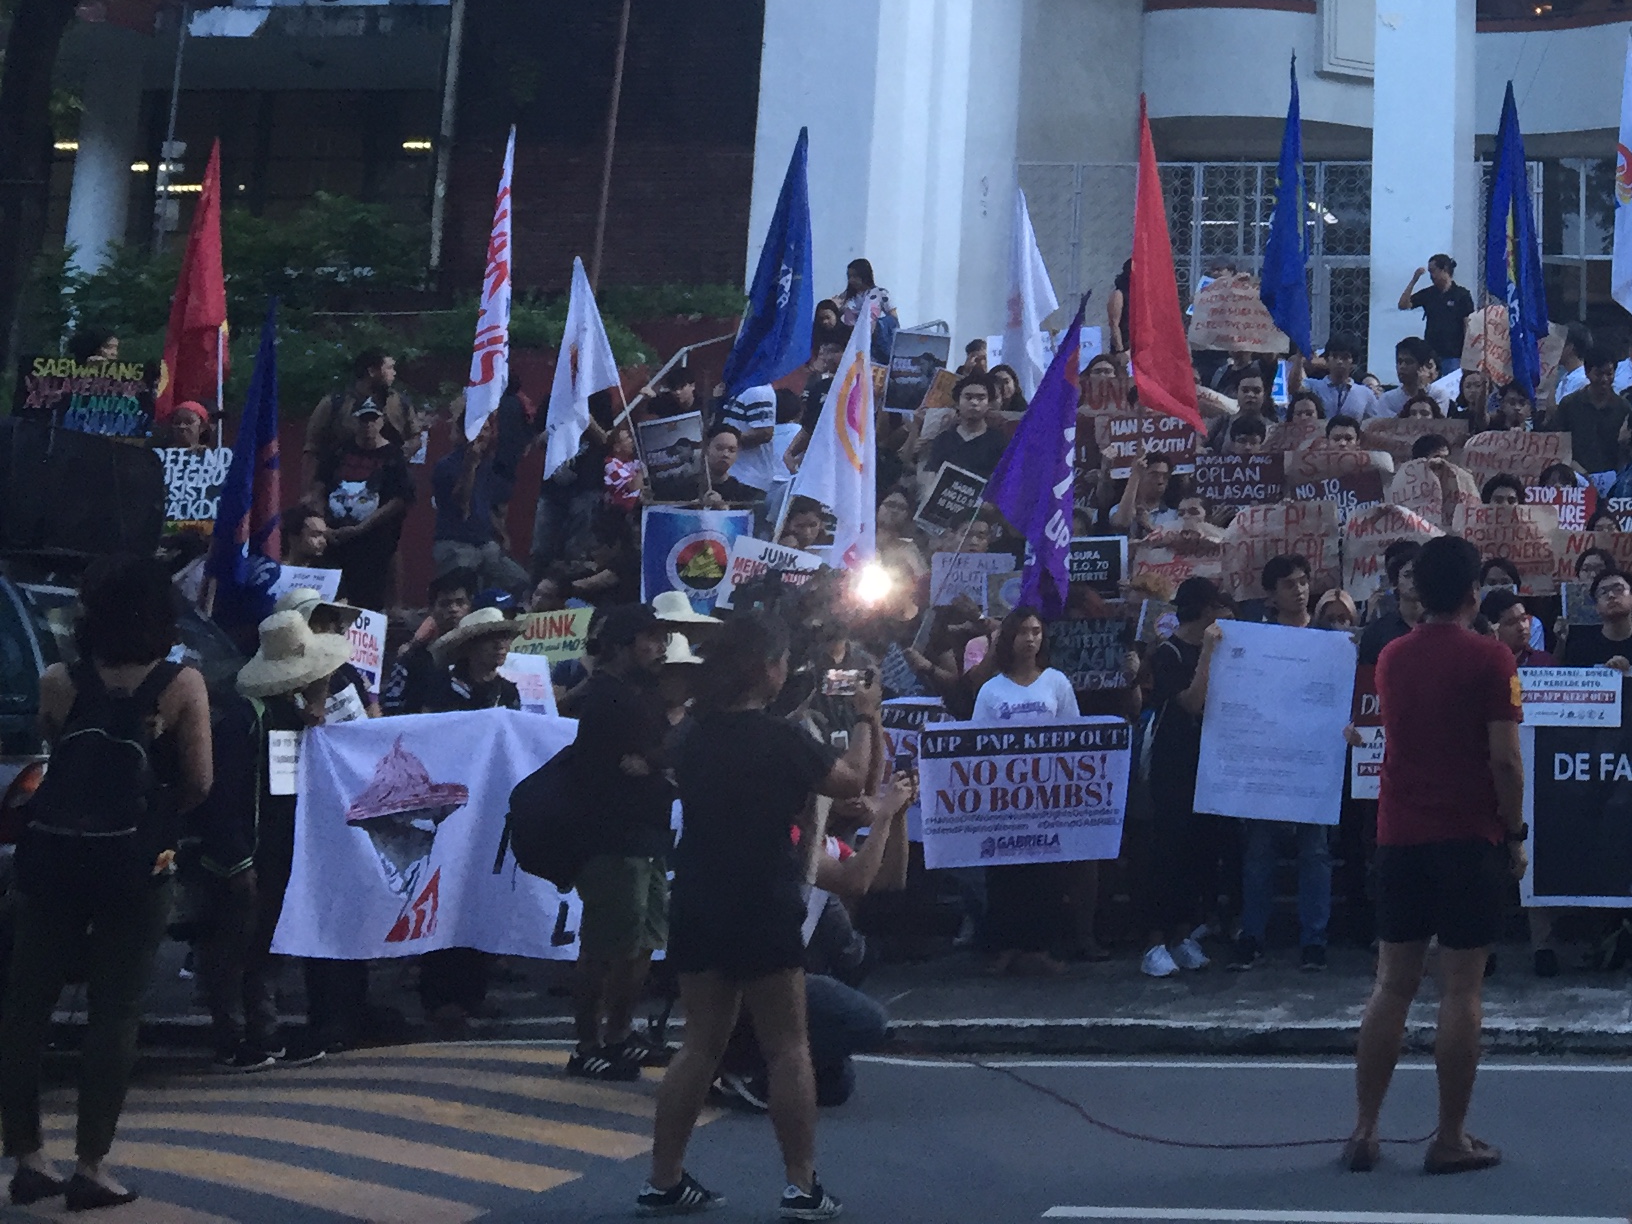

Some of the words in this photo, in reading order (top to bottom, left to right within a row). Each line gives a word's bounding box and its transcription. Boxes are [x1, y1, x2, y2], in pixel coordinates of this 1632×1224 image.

[1196, 467, 1261, 483] OPLAN
[1296, 482, 1316, 498] NO
[1321, 479, 1340, 494] TO
[1525, 487, 1557, 504] STOP
[1560, 487, 1585, 503] THE
[1465, 507, 1504, 524] FREE
[1511, 507, 1534, 524] ALL
[1464, 526, 1546, 542] POLITICAL
[758, 547, 799, 569] JUNK
[1096, 560, 1110, 571] 70
[521, 613, 577, 640] JUNK
[924, 735, 962, 754] AFP
[975, 733, 1019, 752] PNP.
[1024, 731, 1076, 750] KEEP
[1079, 727, 1129, 747] OUT!
[951, 759, 998, 786] NO
[1005, 753, 1108, 785] GUNS!
[1554, 752, 1591, 781] DE
[936, 788, 981, 814] NO
[990, 781, 1114, 812] BOMBS!
[996, 833, 1061, 850] GABRIELA
